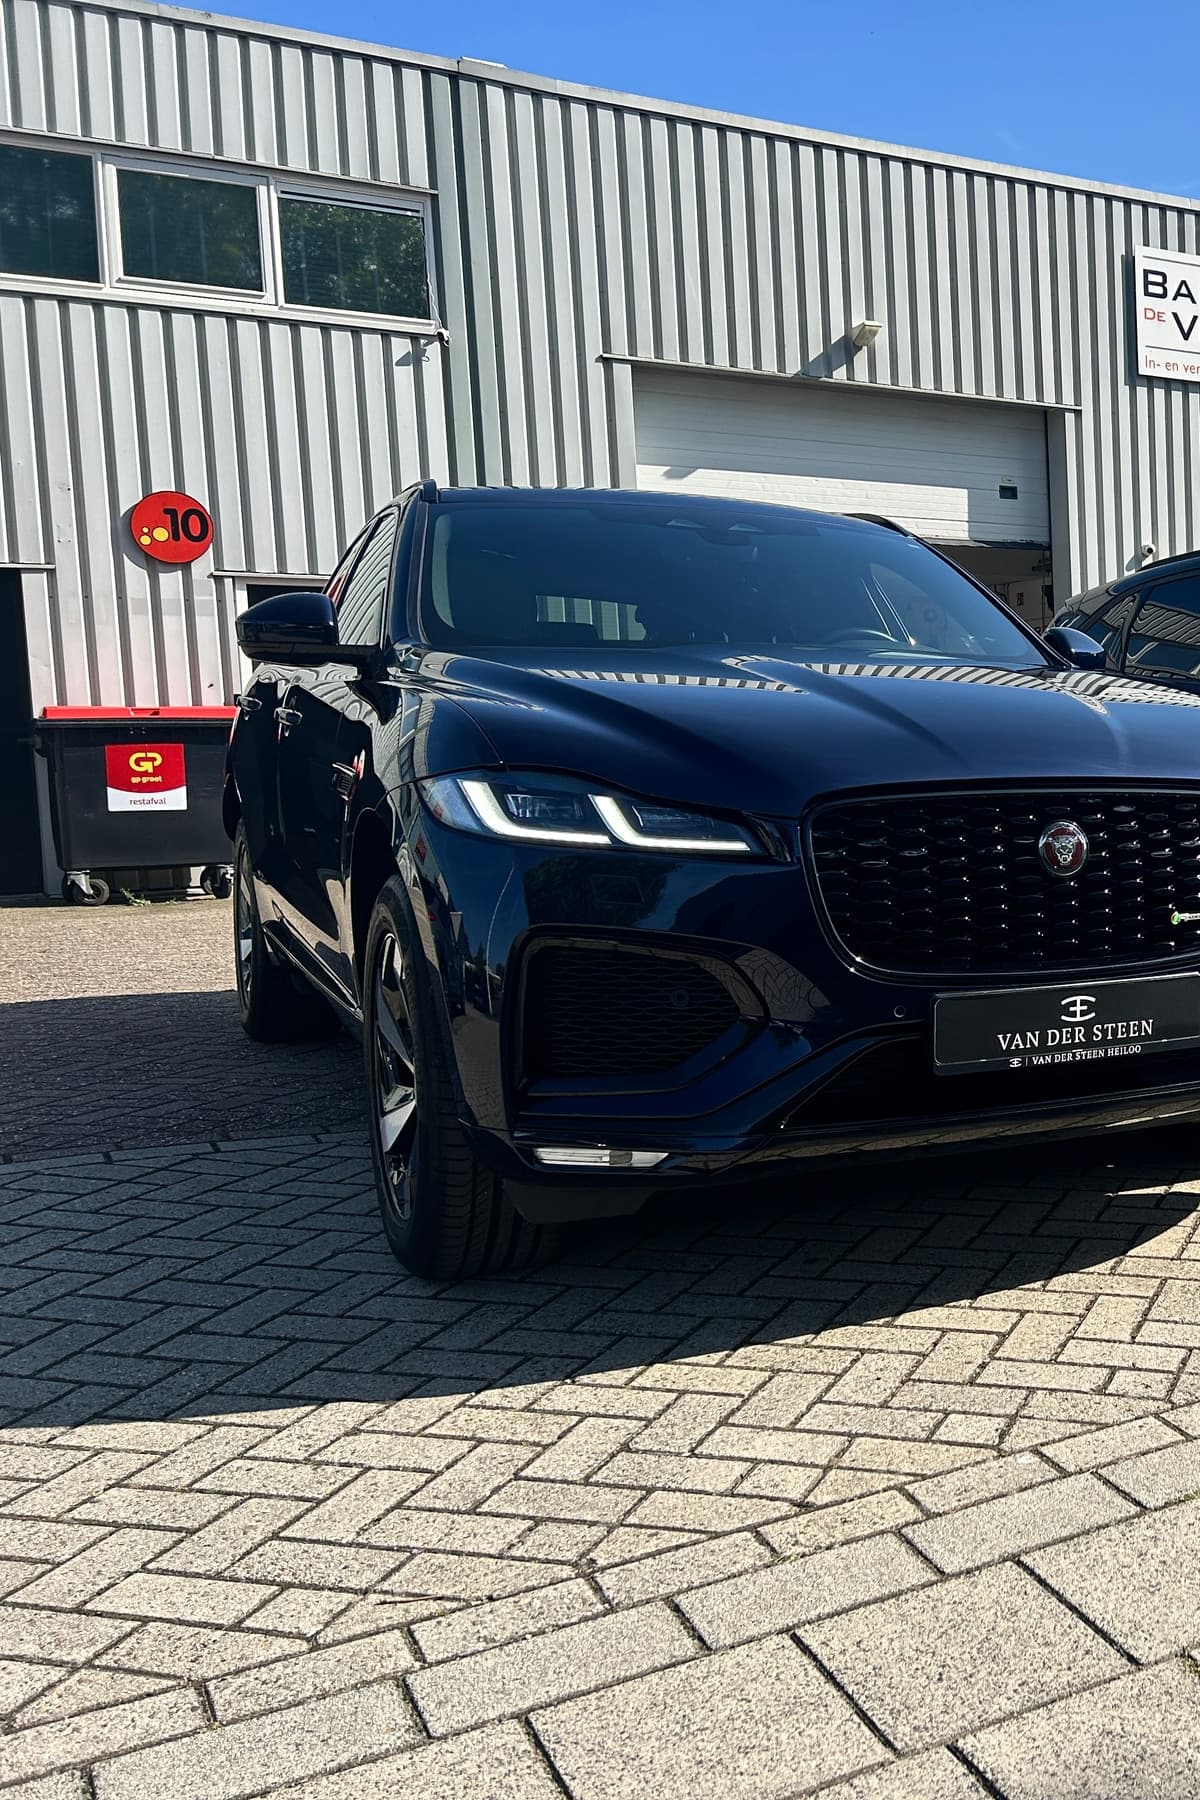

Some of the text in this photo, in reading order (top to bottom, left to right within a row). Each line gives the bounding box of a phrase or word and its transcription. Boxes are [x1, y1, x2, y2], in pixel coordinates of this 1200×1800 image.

[1143, 307, 1166, 323] DE
[1145, 355, 1160, 370] In-
[1165, 362, 1179, 373] en
[163, 507, 209, 543] 10
[129, 752, 163, 773] GP
[129, 797, 166, 805] restafval
[998, 1019, 1154, 1051] VAN DER STEEN
[1032, 1045, 1142, 1065] VAN DER STEEN HEILOO
